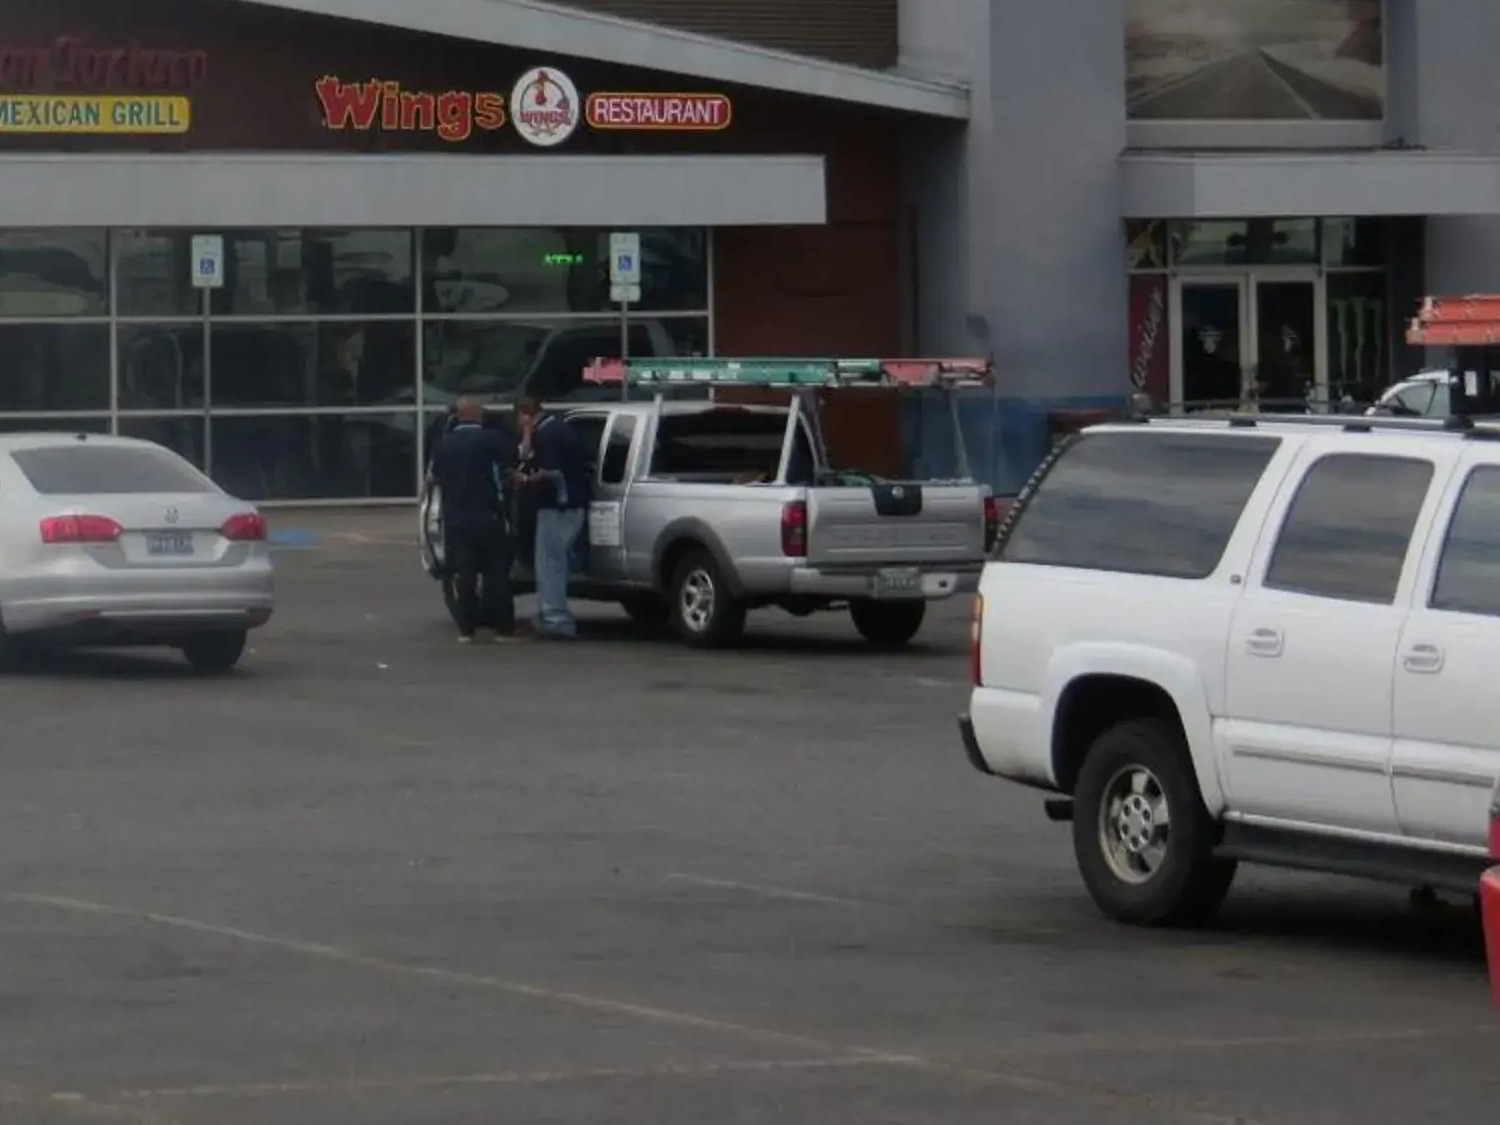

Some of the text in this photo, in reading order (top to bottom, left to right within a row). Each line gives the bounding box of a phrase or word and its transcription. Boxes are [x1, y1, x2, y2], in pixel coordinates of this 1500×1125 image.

[112, 100, 181, 126] GRILL
[317, 75, 506, 142] Wings
[594, 97, 723, 125] RESTAURANT
